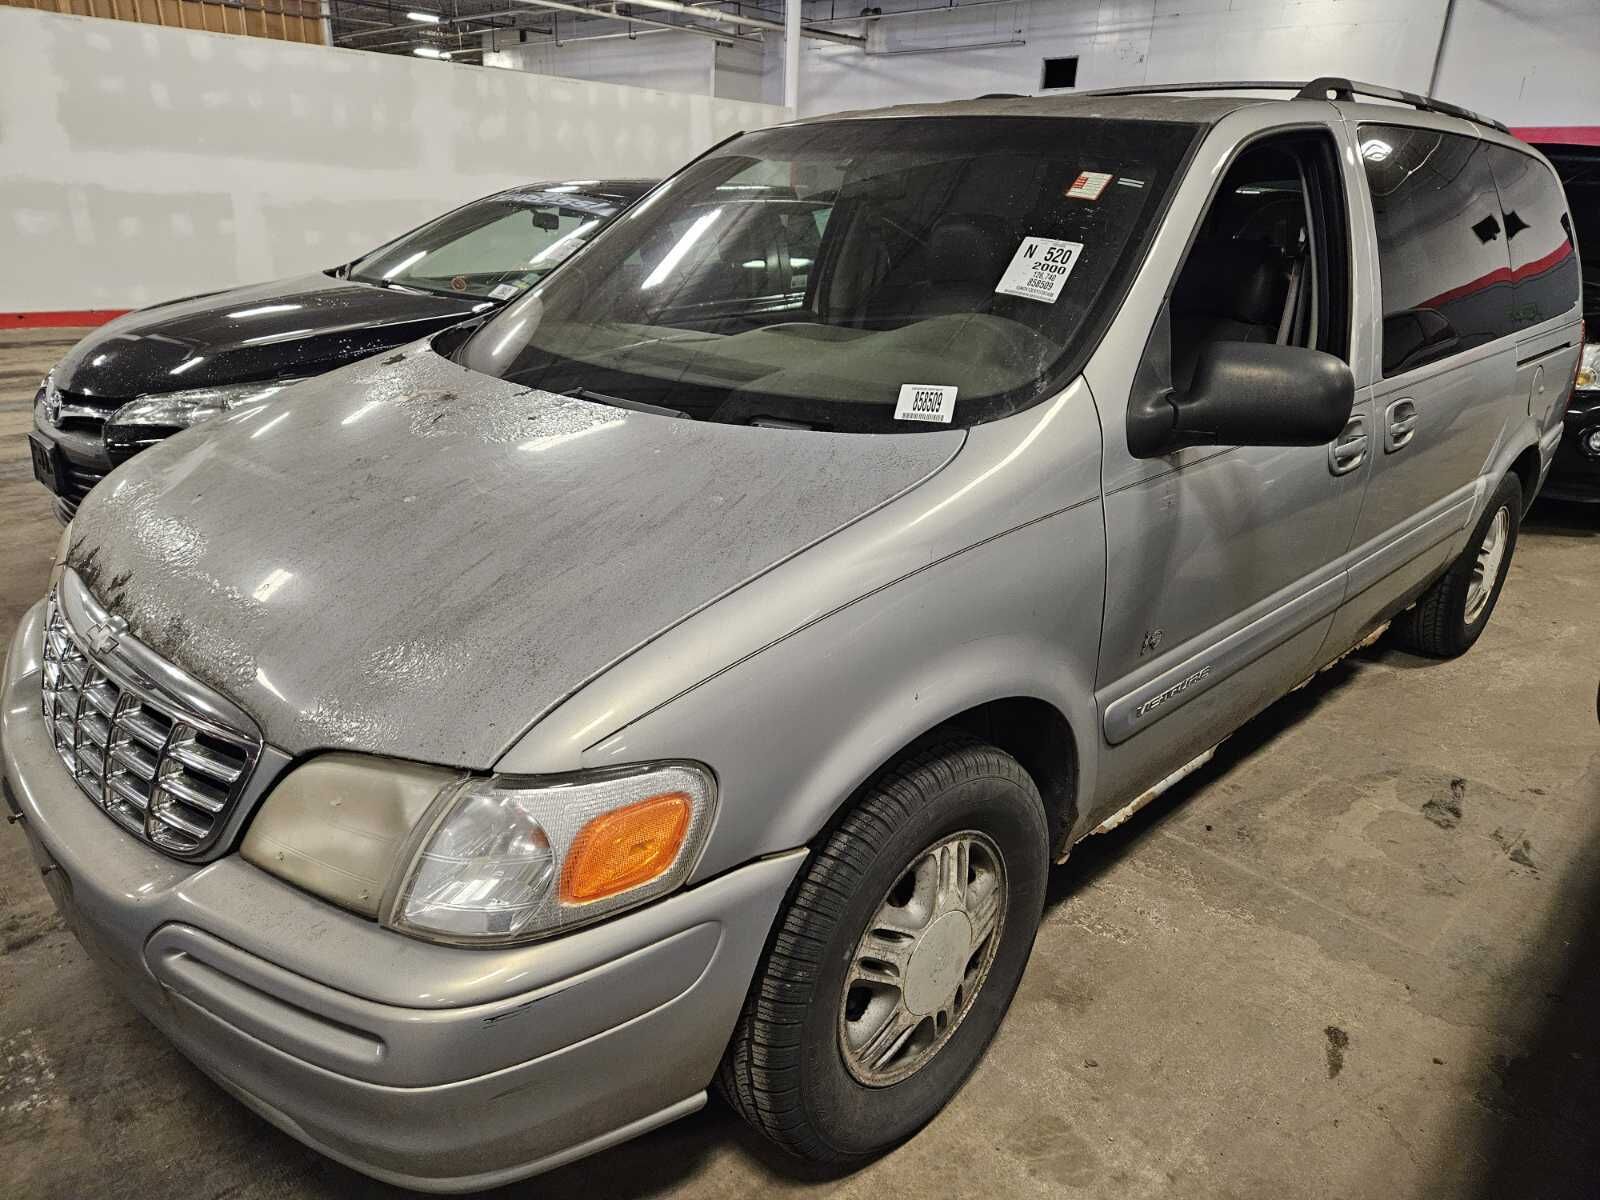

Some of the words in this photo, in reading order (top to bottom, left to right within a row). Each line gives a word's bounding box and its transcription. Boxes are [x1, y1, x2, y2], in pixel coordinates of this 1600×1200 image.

[1024, 244, 1039, 258] N
[1044, 247, 1072, 264] 520
[1032, 262, 1067, 275] 2000
[1027, 278, 1054, 290] 858509
[912, 391, 943, 412] 858509
